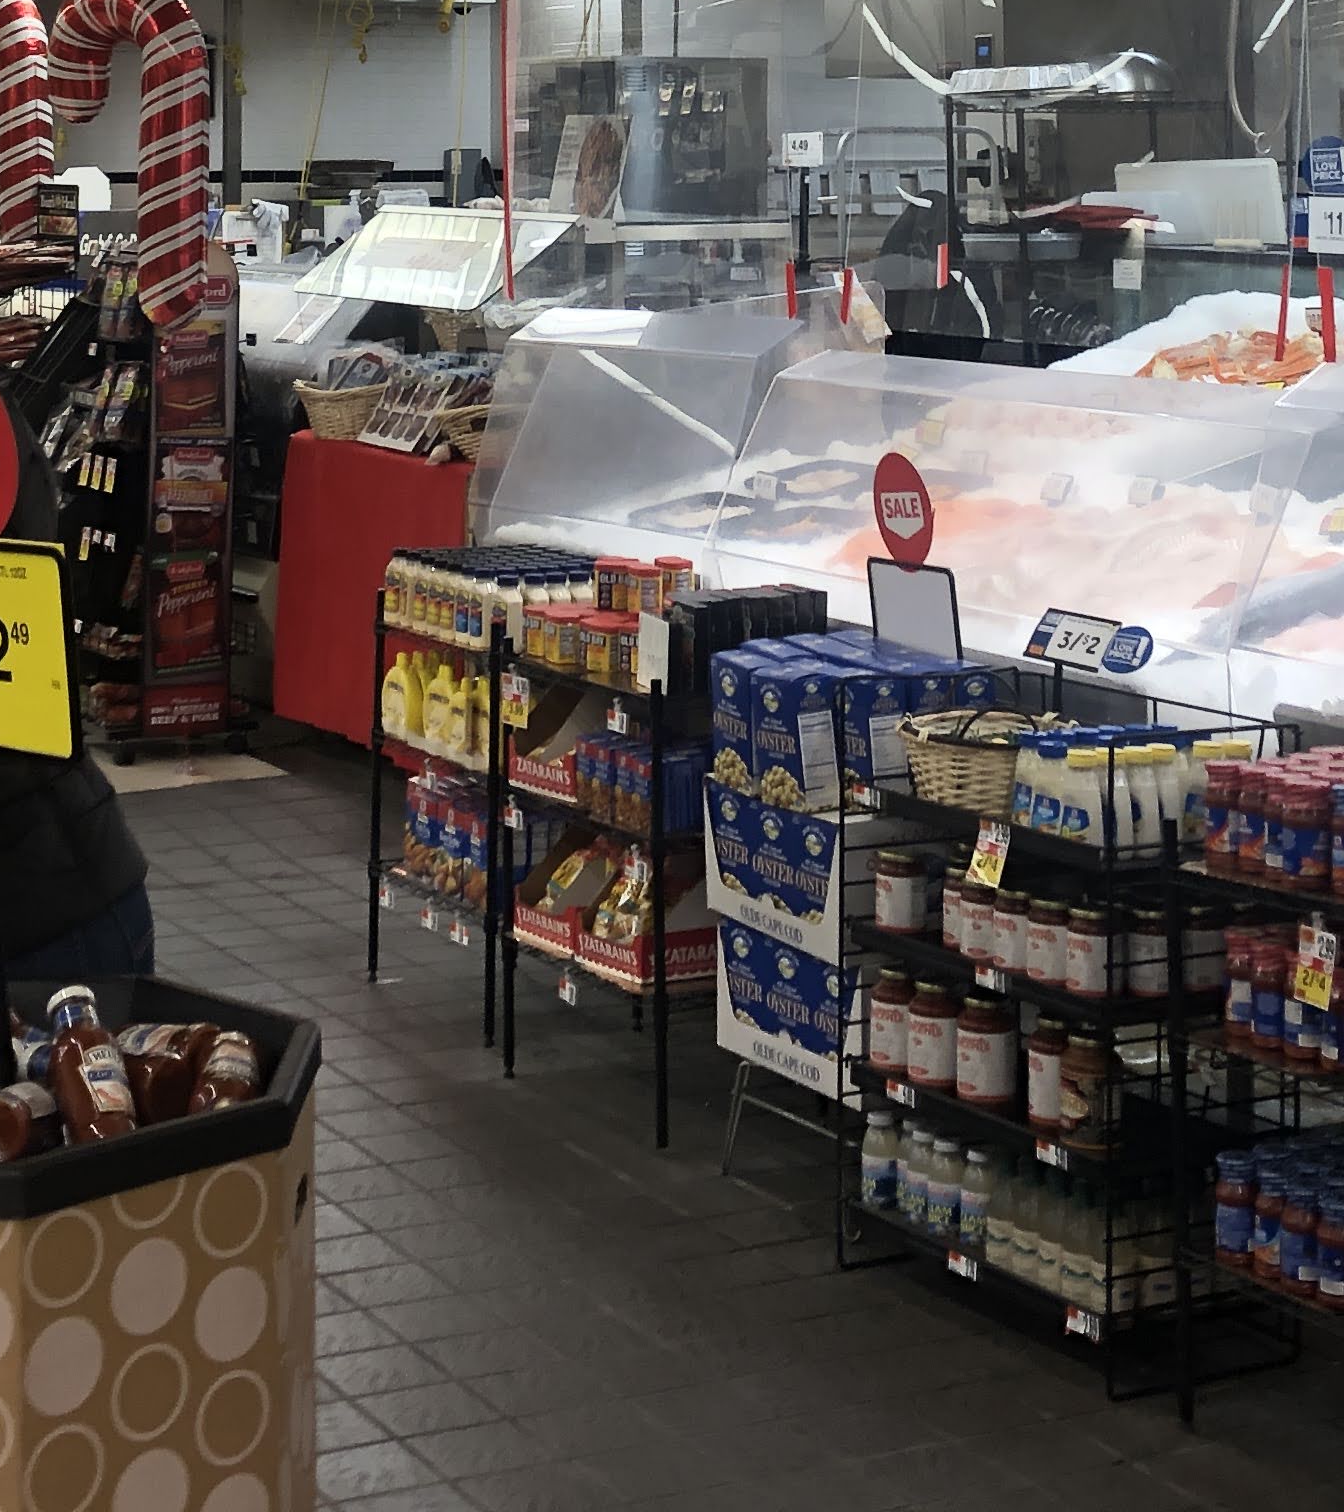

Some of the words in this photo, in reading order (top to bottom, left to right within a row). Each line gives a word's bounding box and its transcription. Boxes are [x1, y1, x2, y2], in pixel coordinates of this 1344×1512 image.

[884, 497, 921, 519] SALE
[713, 710, 748, 741] OYSTER
[757, 728, 797, 755] OYSTER
[516, 757, 572, 786] ZATARAIN'S
[718, 837, 749, 866] YSTER
[752, 853, 794, 886] OYSTER
[795, 870, 831, 898] OYSTE
[522, 908, 572, 937] ZATARAIN'S
[584, 934, 638, 966] ZATARAIN'S
[664, 941, 718, 965] ZATARA
[729, 973, 762, 1004] YSTER
[766, 990, 810, 1026] OYSTER
[813, 1009, 839, 1038] OYST
